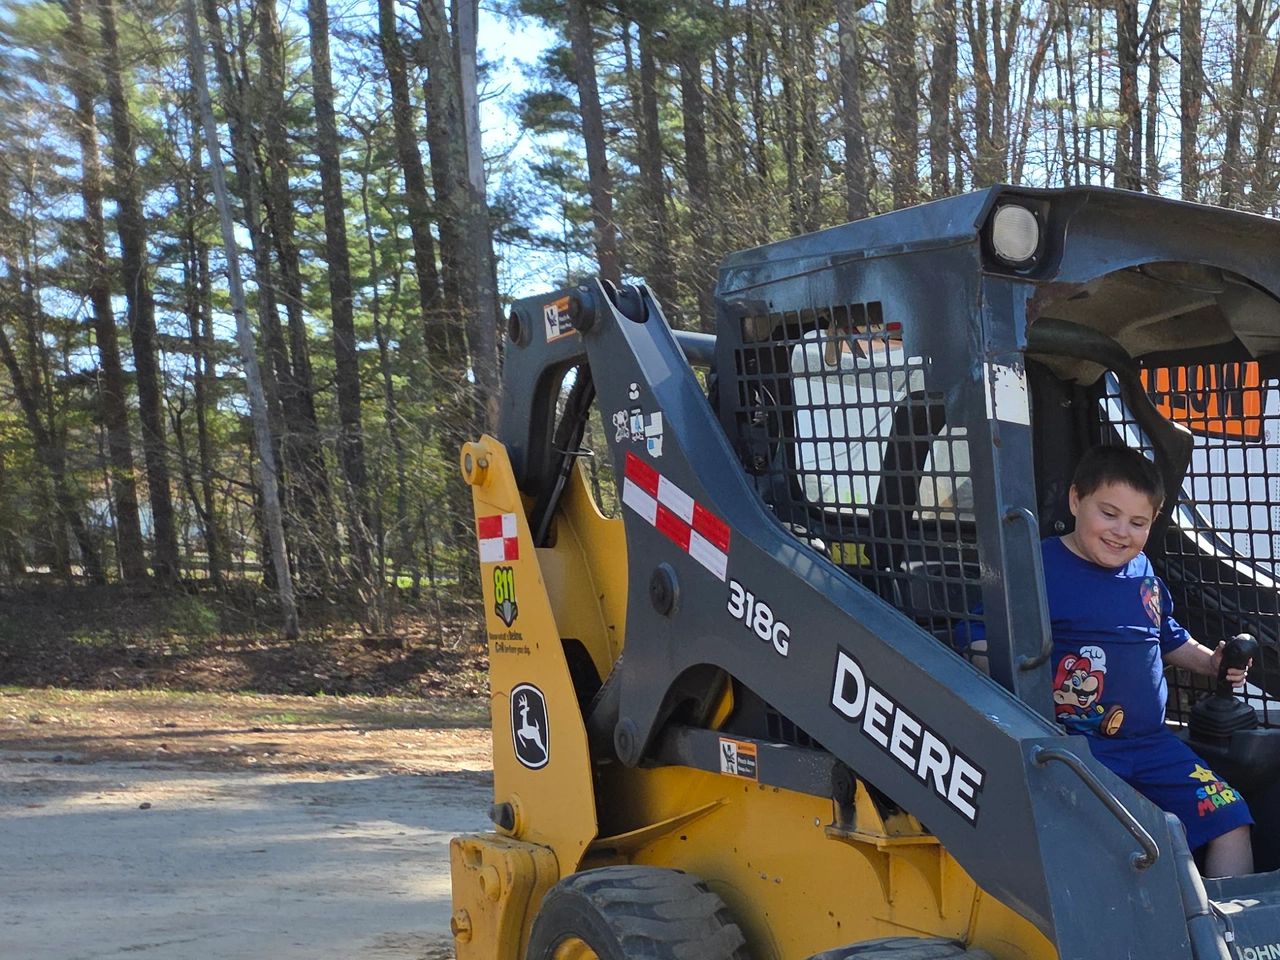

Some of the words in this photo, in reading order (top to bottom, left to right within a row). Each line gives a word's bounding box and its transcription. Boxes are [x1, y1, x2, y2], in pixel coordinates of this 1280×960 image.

[493, 567, 515, 605] 811
[727, 580, 791, 657] 318G
[831, 650, 983, 821] DEERE
